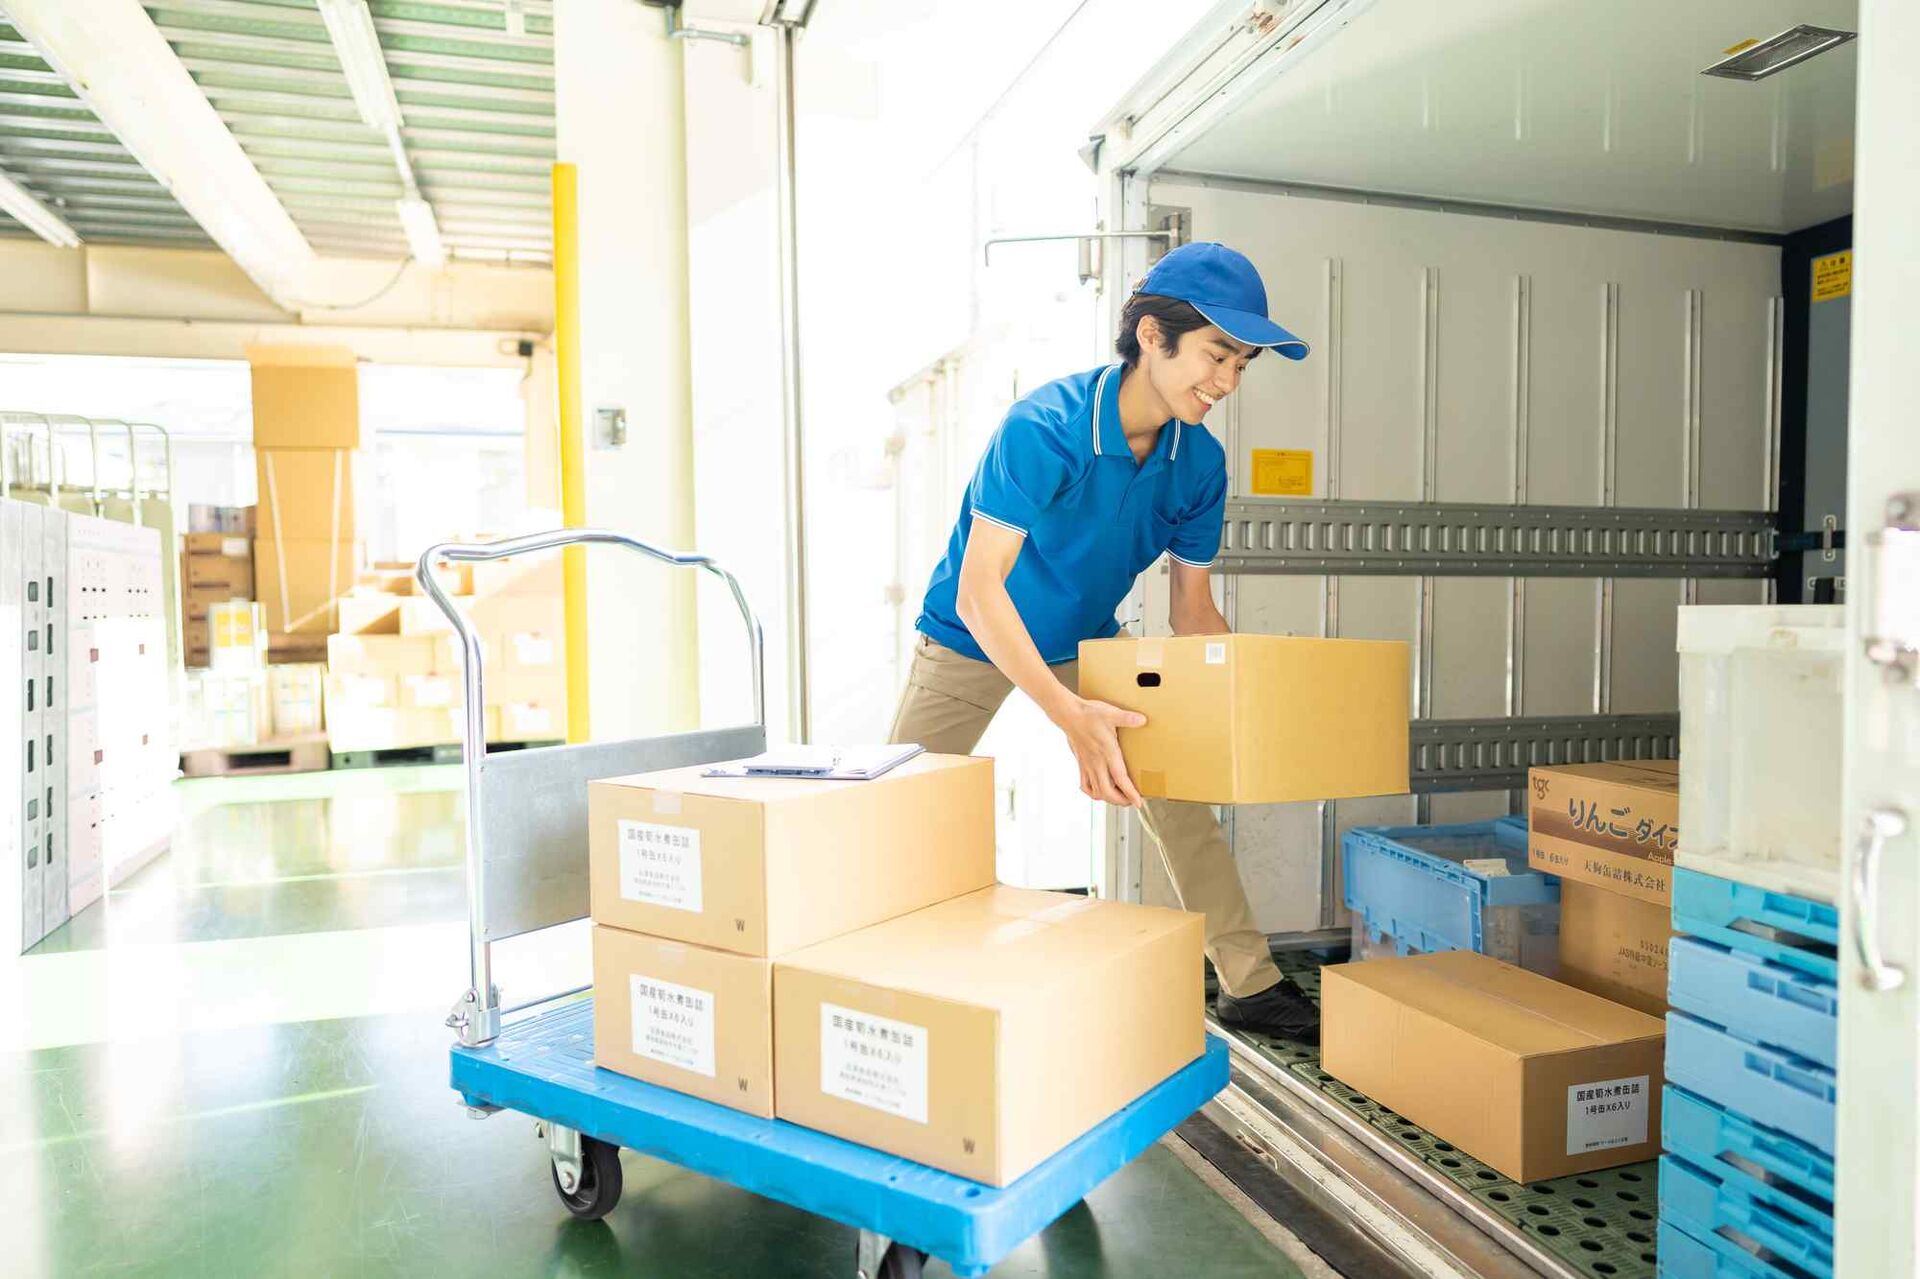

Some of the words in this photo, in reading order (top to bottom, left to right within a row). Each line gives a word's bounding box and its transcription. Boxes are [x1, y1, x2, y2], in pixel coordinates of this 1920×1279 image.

[734, 918, 745, 932] W
[737, 1074, 748, 1092] W
[962, 1137, 975, 1154] W
